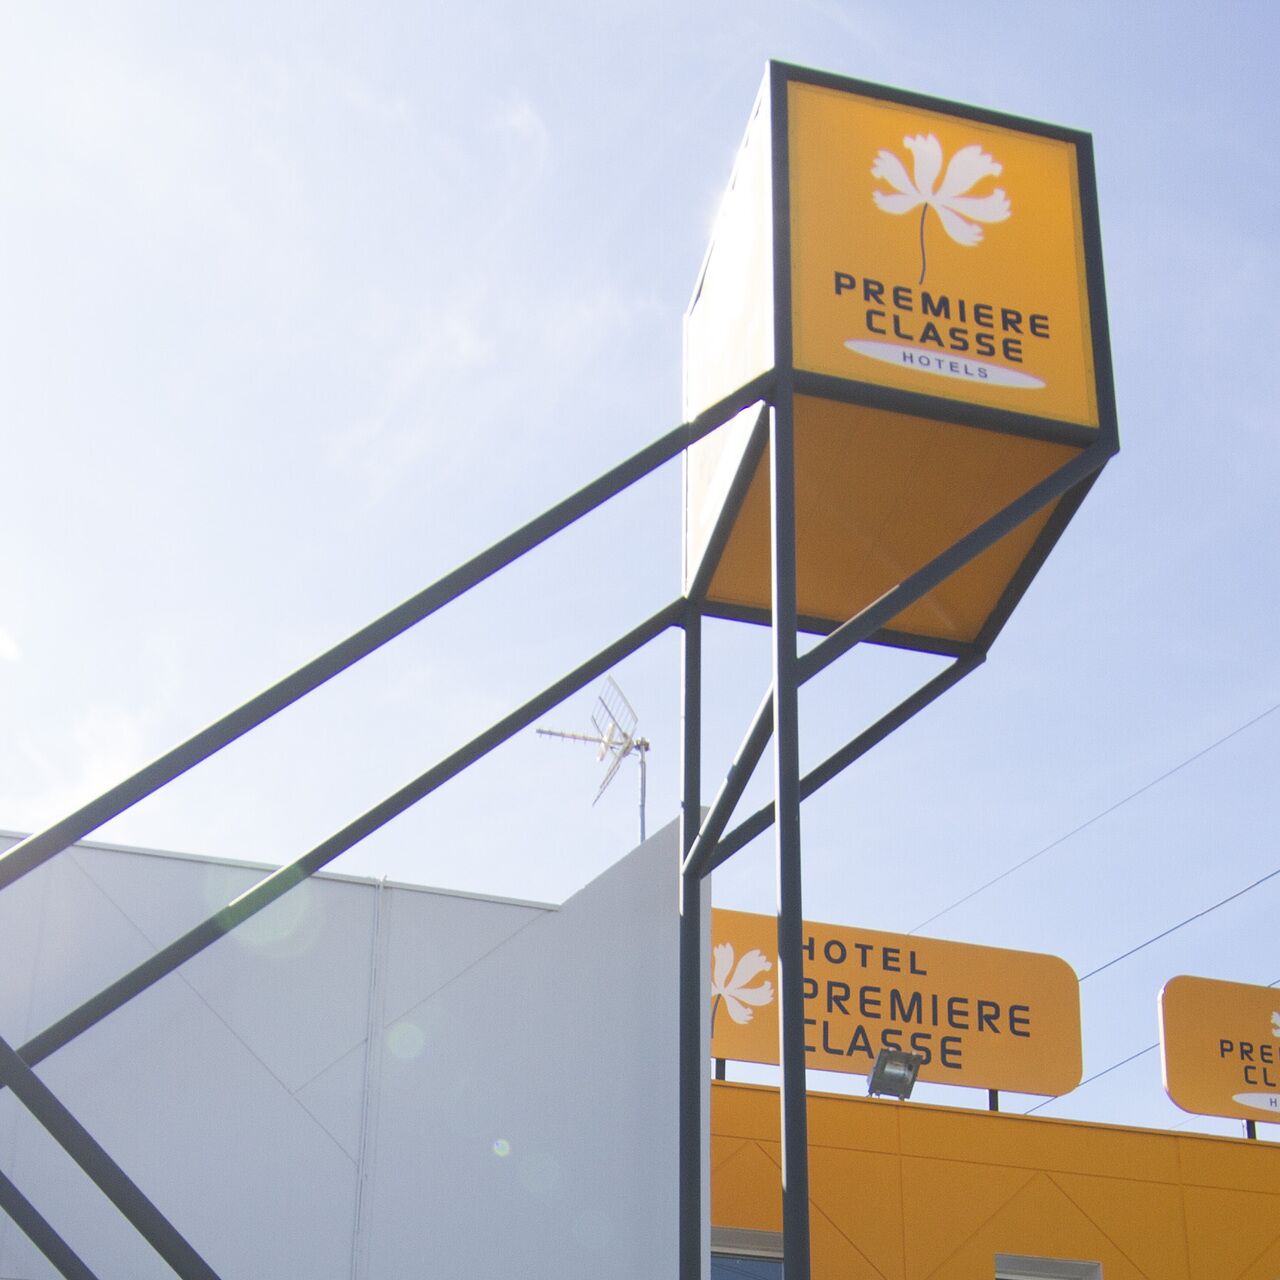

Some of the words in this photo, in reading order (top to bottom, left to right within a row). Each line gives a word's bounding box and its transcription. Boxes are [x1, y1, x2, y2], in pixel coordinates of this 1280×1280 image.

[834, 271, 1050, 339] PREMIERE
[865, 310, 1024, 363] CLASSE
[902, 351, 990, 379] HOTELS
